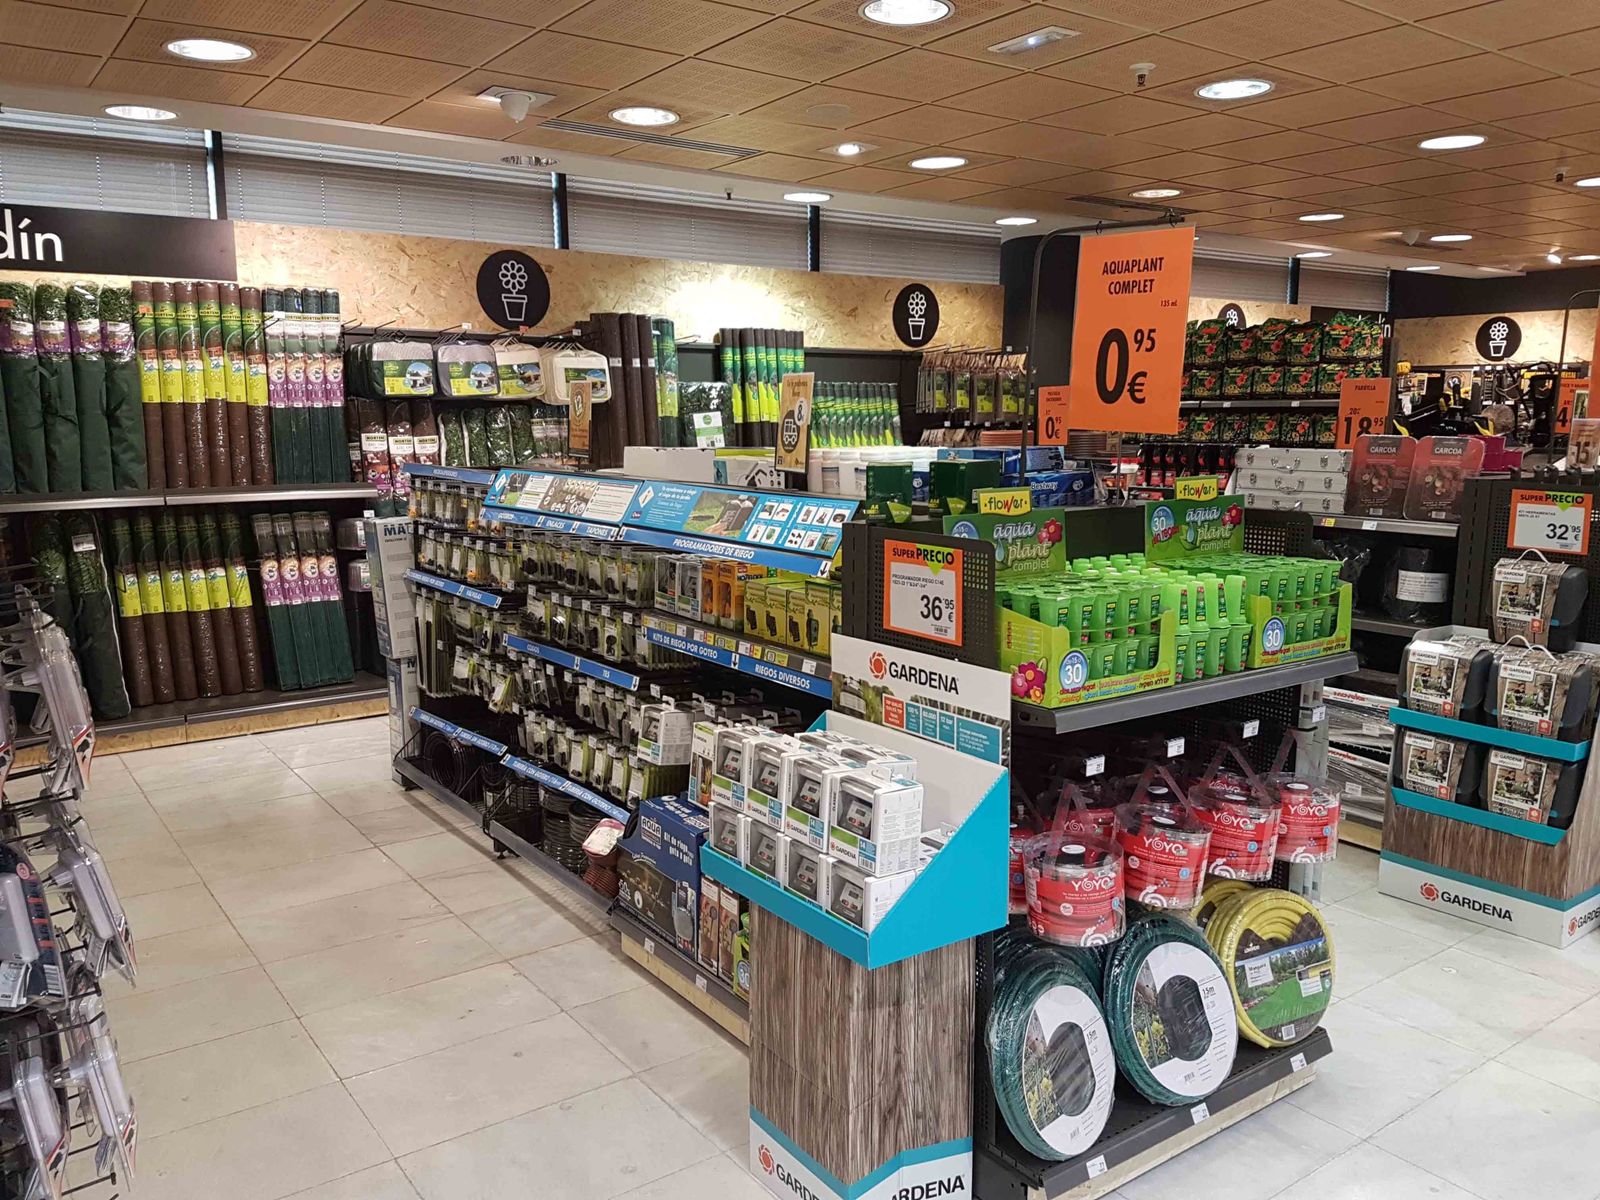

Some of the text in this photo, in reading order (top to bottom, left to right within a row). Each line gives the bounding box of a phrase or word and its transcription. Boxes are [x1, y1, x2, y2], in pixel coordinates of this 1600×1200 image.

[1102, 256, 1165, 276] AQUAPLANT
[1108, 278, 1155, 295] COMPLET
[1096, 327, 1156, 405] 0 95
[1127, 371, 1148, 404] €
[1045, 416, 1055, 439] 0
[1370, 446, 1397, 454] CARCOA
[1434, 447, 1462, 455] CARCOA
[1031, 482, 1058, 491] Bestway
[1183, 481, 1213, 498] flower
[987, 496, 1024, 513] flower
[1520, 494, 1585, 504] SUPER PRECIO
[586, 525, 608, 537] TAPONES
[1153, 517, 1166, 531] 30
[1546, 523, 1569, 540] 32
[1196, 522, 1233, 547] plant
[672, 537, 755, 560] PROGRAMADORES DE RIEGO
[1008, 539, 1051, 565] plant
[1201, 540, 1231, 551] complet
[892, 547, 955, 566] SUPER PRECIO
[1013, 557, 1050, 572] complet
[920, 594, 943, 622] 36
[652, 633, 718, 659] KITS DE RIEGO POR GOTEO
[1265, 629, 1280, 648] 30
[755, 664, 811, 689] RIEGOS DIVERSOS
[889, 661, 959, 696] GARDENA
[1064, 663, 1082, 685] 30
[642, 818, 661, 835] AQUA
[835, 846, 856, 860] GARDENA
[1441, 890, 1514, 922] GARDENA
